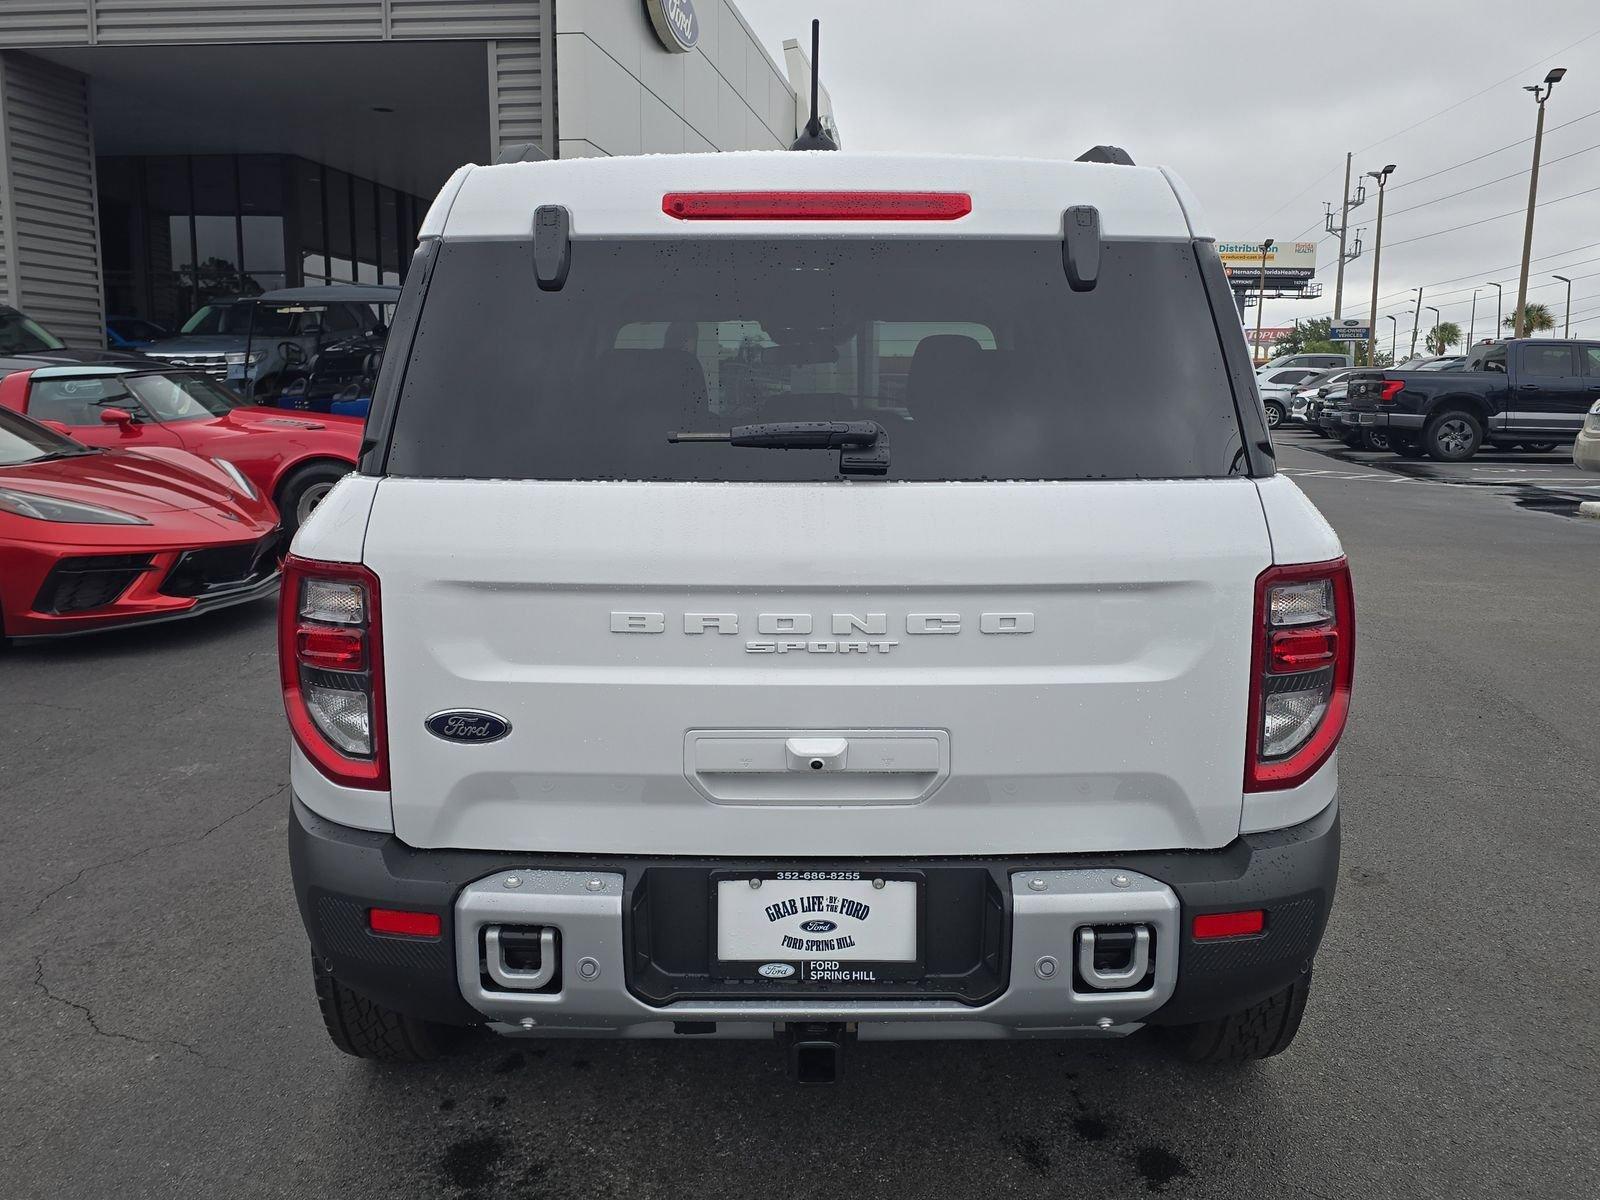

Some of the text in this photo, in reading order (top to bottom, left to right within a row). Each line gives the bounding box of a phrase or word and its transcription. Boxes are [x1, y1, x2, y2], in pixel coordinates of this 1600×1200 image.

[1218, 243, 1279, 253] Distribuon
[1232, 269, 1312, 277] Hernando.loridaHealth.gov
[610, 610, 1036, 635] BRONCO
[745, 640, 899, 655] SPORT
[443, 715, 490, 737] Ford
[776, 871, 860, 880] 352-686-8255
[764, 898, 799, 922] GRAB
[799, 895, 825, 913] LIFE
[825, 904, 839, 913] THE
[839, 898, 871, 921] FORD
[806, 921, 831, 932] Ford
[781, 934, 856, 952] FORD SPRING HILL
[764, 961, 840, 976] Ford FORD
[810, 970, 876, 981] SPRING HILL
